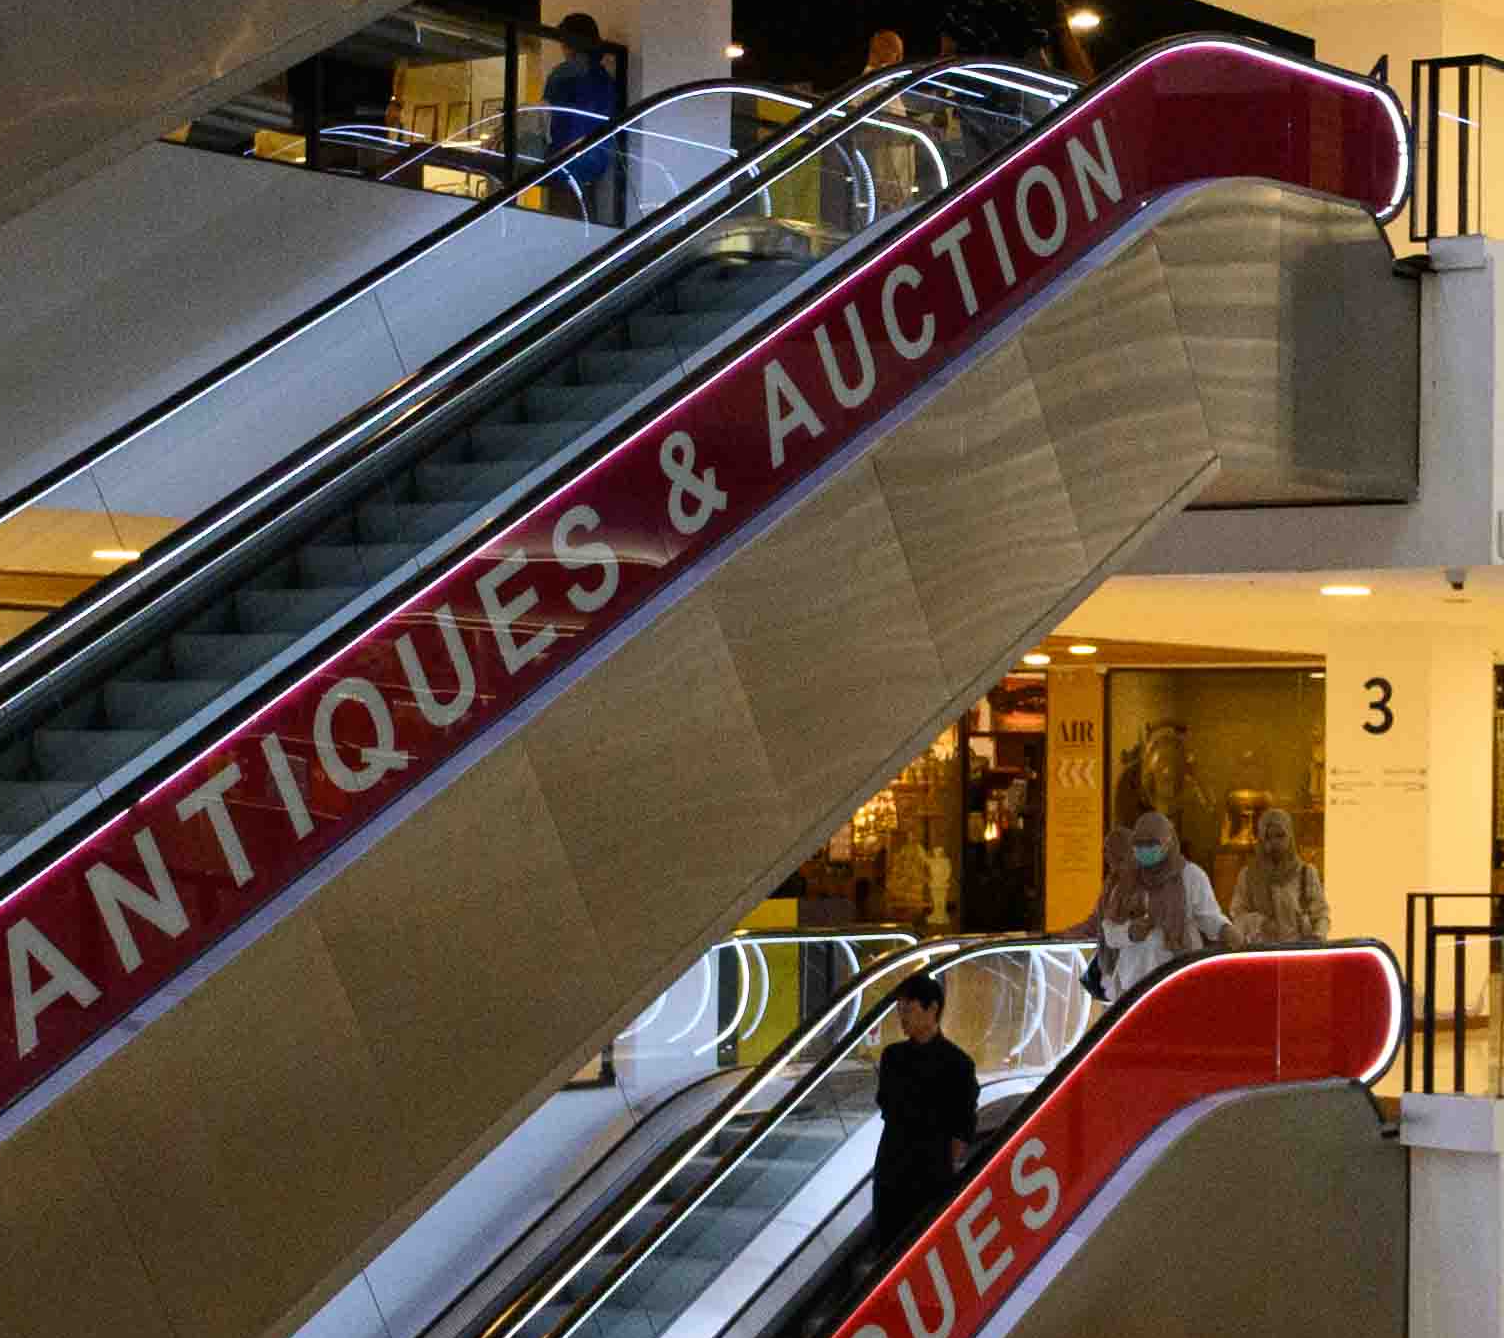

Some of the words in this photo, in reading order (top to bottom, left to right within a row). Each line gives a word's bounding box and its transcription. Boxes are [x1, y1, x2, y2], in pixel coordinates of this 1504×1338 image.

[6, 503, 620, 1059] ANTIQUES
[661, 430, 727, 534] &
[763, 119, 1125, 467] AUCTION
[1058, 719, 1096, 743] AIR
[1362, 677, 1394, 736] 3
